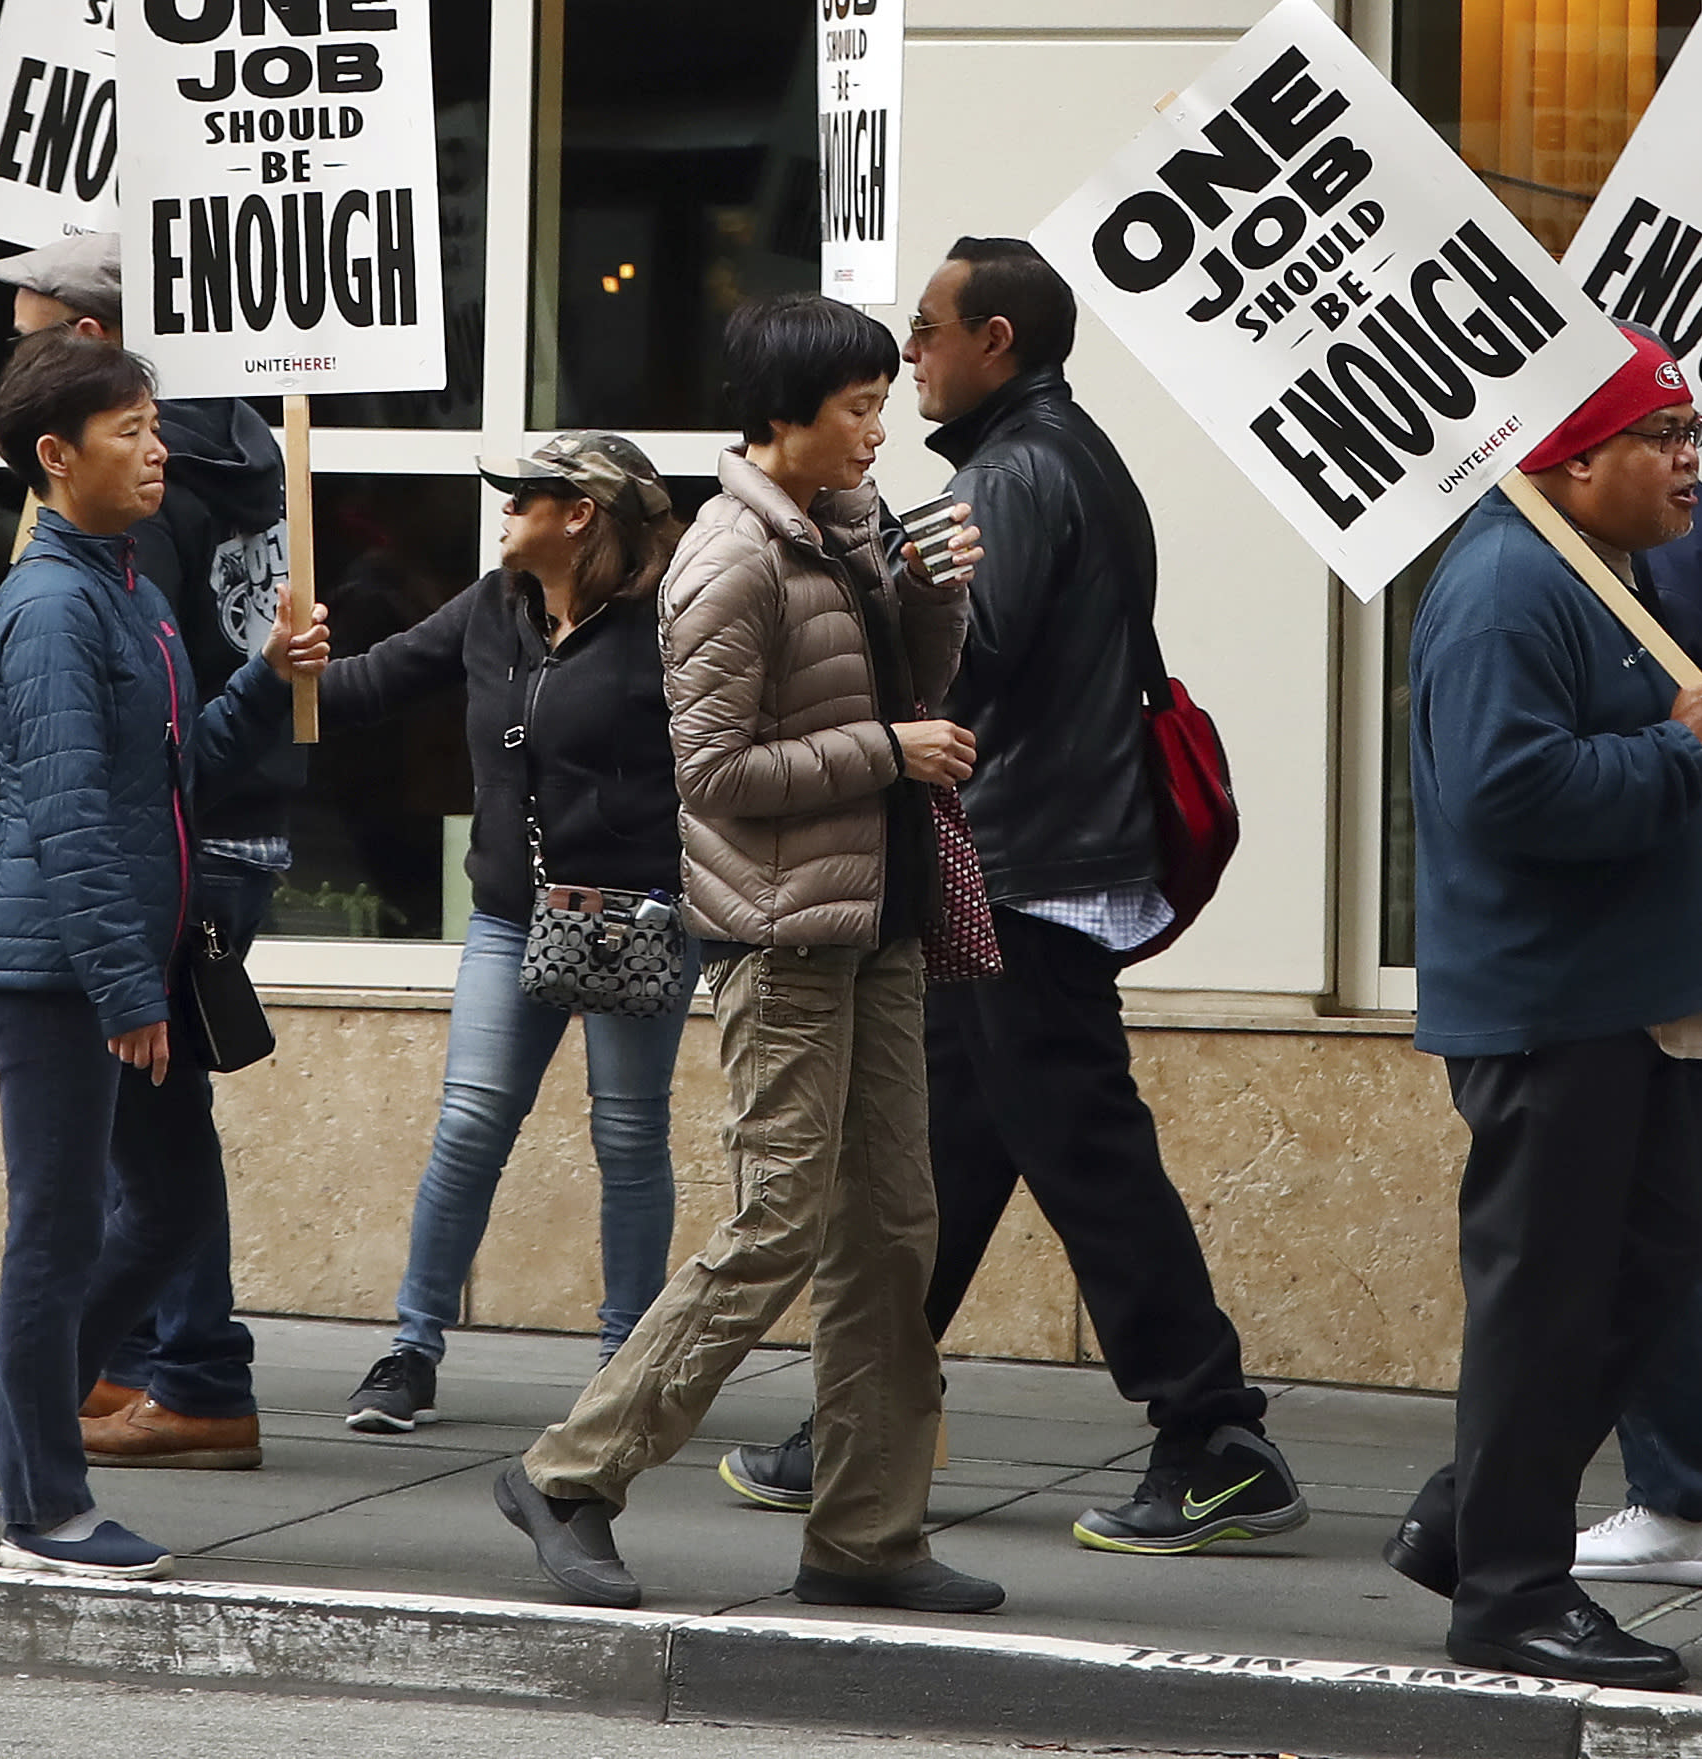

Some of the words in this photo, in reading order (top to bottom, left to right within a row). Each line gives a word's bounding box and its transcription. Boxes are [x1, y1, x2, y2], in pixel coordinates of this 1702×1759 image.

[177, 43, 382, 102] JOB
[205, 107, 363, 144] SHOULD
[262, 150, 310, 183] BE
[1092, 45, 1350, 293] ONE
[153, 188, 417, 335] ENOUGH
[1186, 137, 1372, 322] JOB
[1236, 201, 1384, 342] SHOULD
[1311, 271, 1372, 331] BE
[1250, 219, 1567, 531] ENOUGH
[1124, 1646, 1300, 1672] TOW
[1345, 1665, 1576, 1694] AWAY
